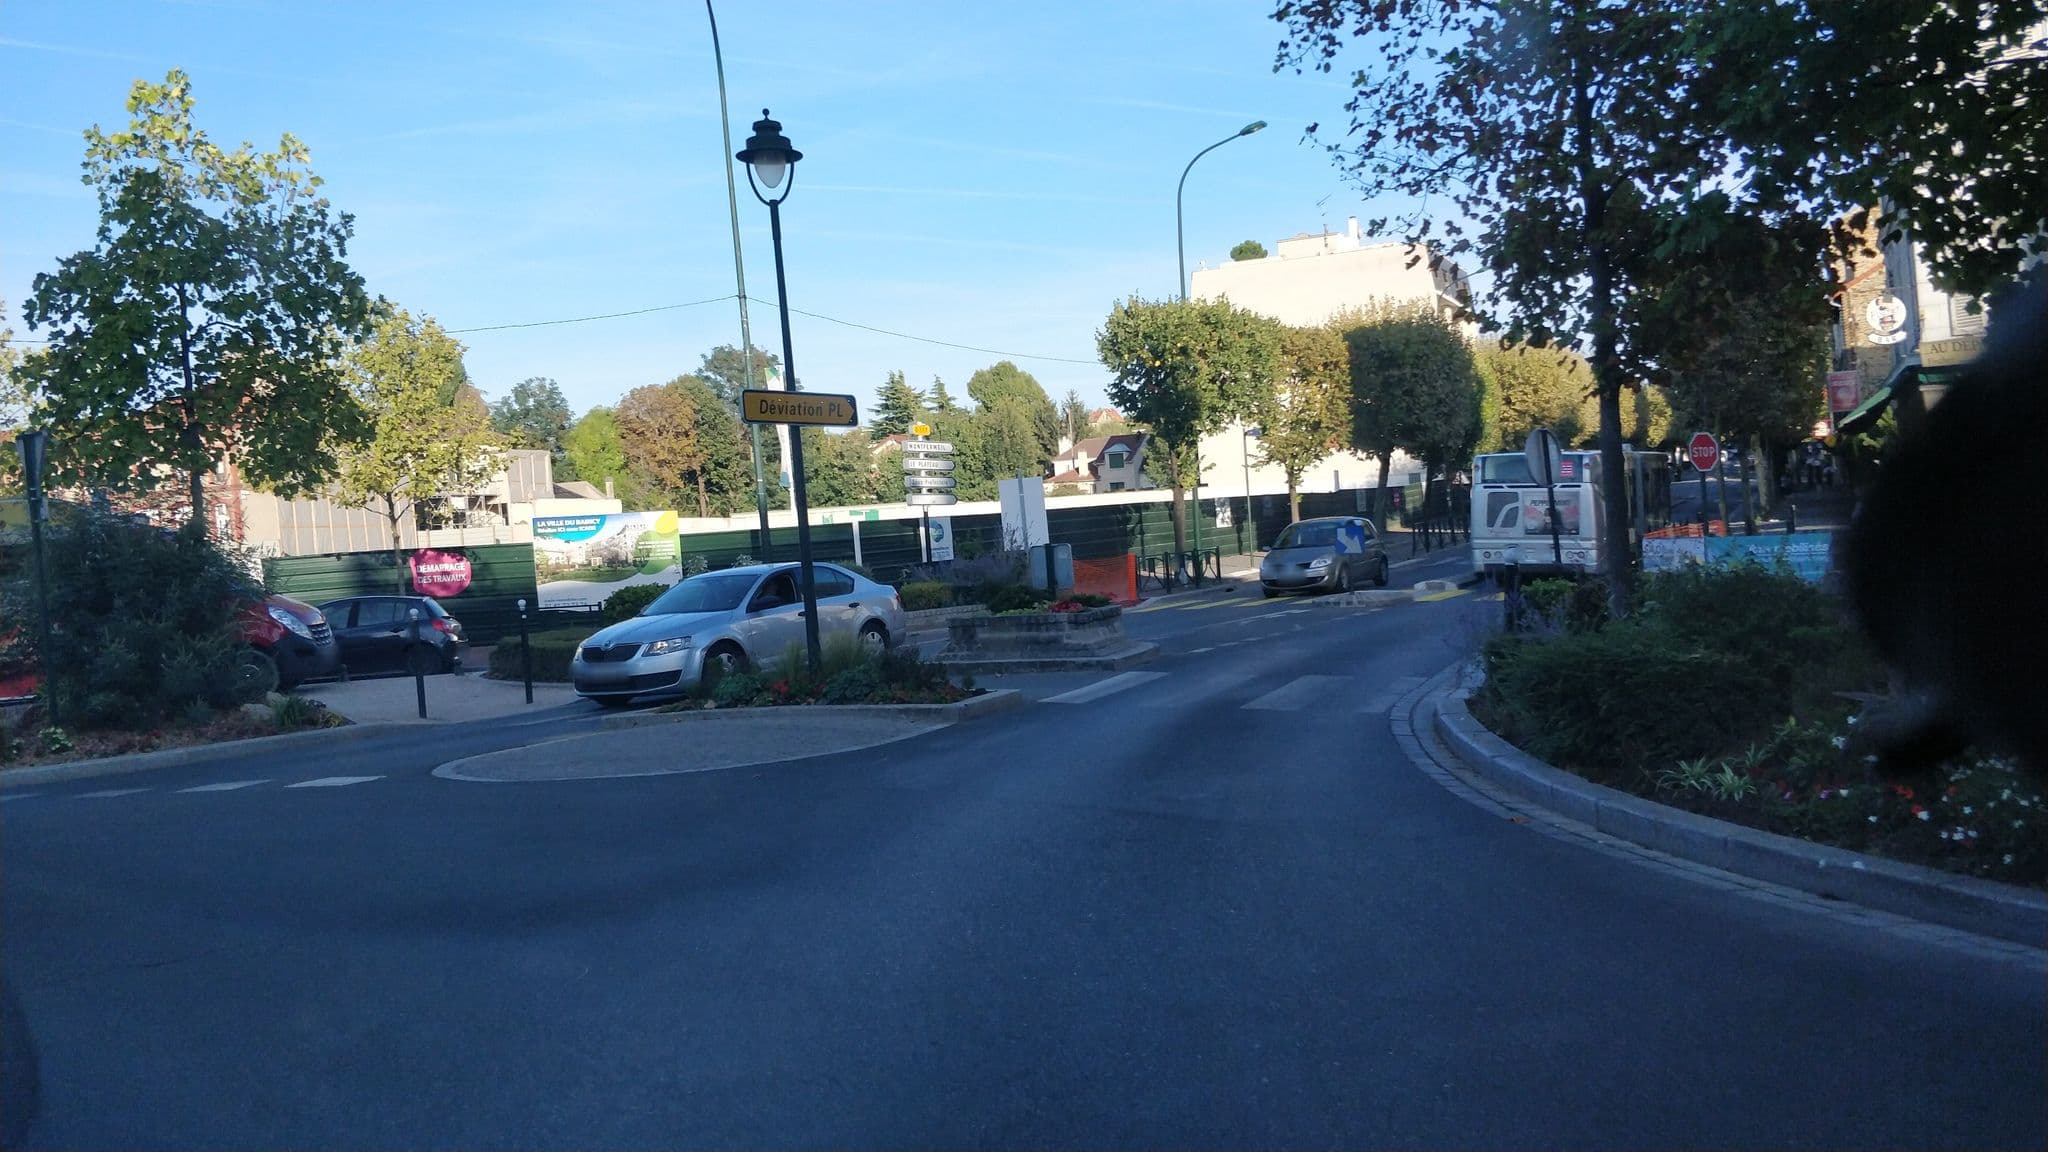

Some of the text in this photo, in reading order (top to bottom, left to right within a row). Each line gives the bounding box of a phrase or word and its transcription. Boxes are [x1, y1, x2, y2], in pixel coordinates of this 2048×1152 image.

[1929, 342, 1947, 354] AU
[759, 397, 844, 418] Déviation PL
[908, 443, 946, 452] MONTFERMEIL
[1691, 446, 1716, 459] STOP
[918, 461, 939, 469] PLATEAU
[416, 562, 466, 573] DÉMARRAGE
[417, 573, 466, 584] DES TRAVAUX
